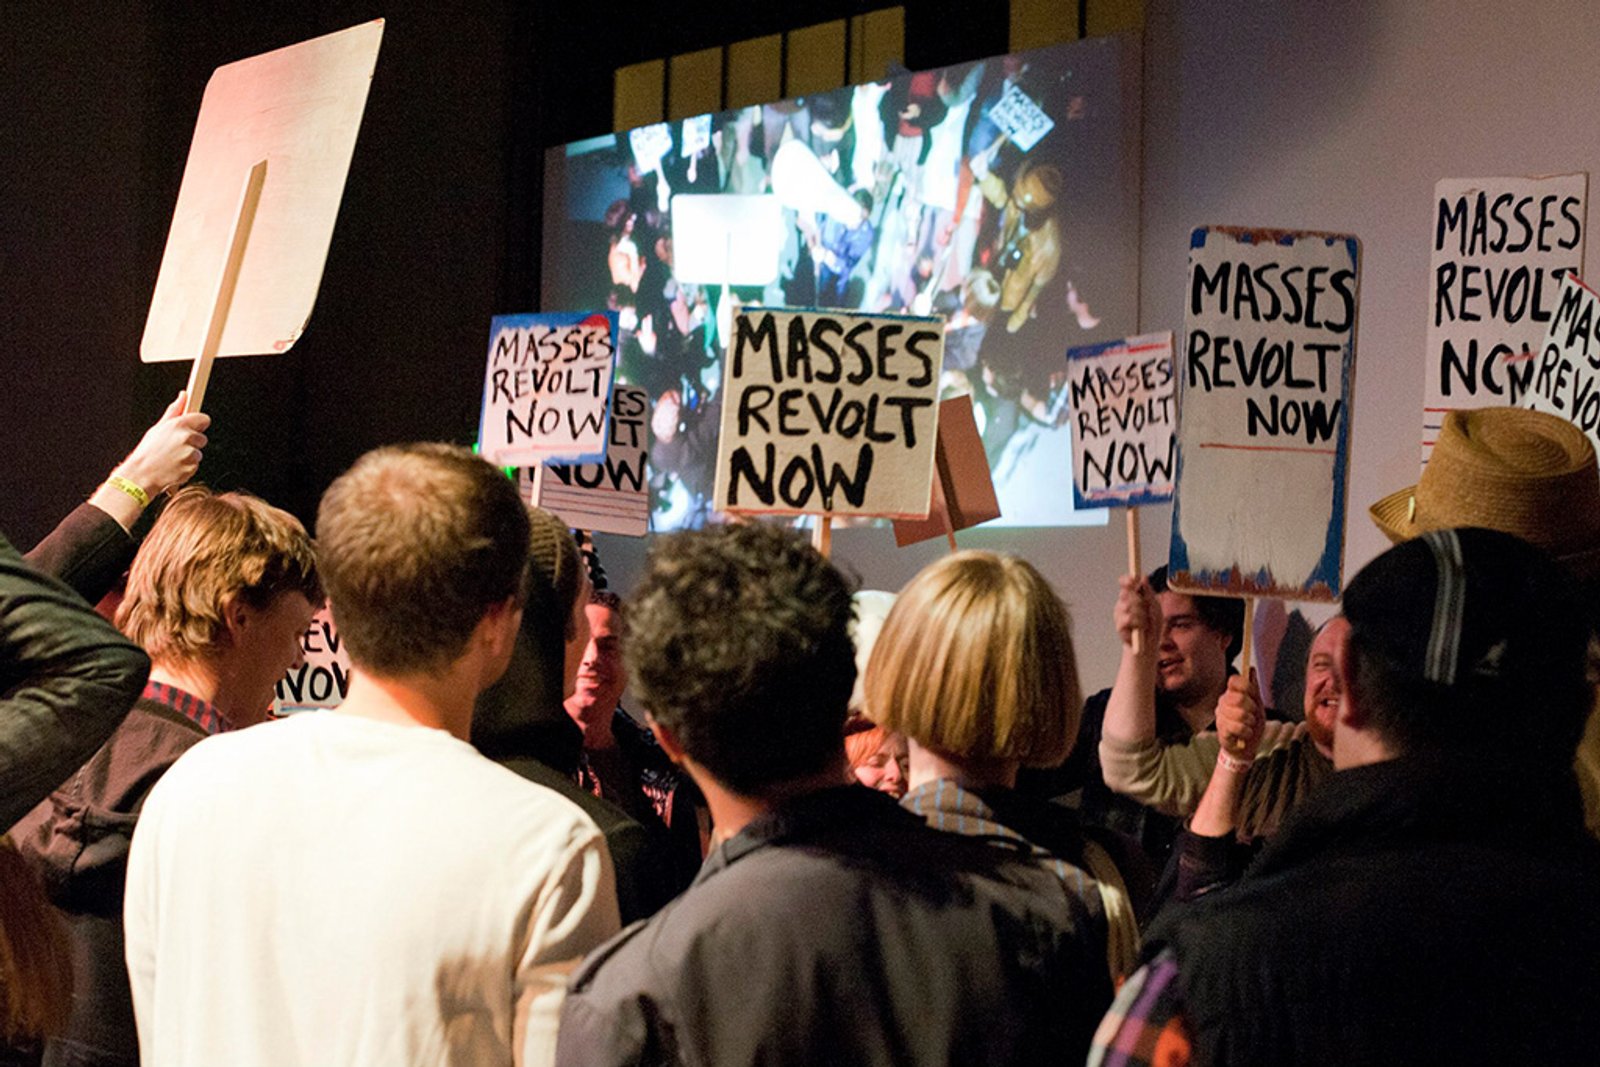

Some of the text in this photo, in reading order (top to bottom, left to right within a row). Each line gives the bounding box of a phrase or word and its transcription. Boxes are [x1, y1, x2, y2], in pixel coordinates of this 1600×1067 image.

[1434, 190, 1582, 256] MASSES
[1190, 261, 1356, 333] MASSES
[493, 328, 615, 367] MASSES
[732, 312, 940, 388] MASSES
[1188, 329, 1341, 393] REVOLT
[1440, 338, 1531, 397] NO
[492, 362, 606, 404] REVOLT
[1071, 356, 1173, 408] MASSES
[1535, 343, 1600, 441] REVO
[506, 399, 610, 445] NOW
[738, 384, 934, 449] REVOLT
[1076, 394, 1174, 440] REVOLT
[1246, 394, 1343, 444] NOW
[727, 441, 874, 509] NOW
[1082, 431, 1176, 492] NOW
